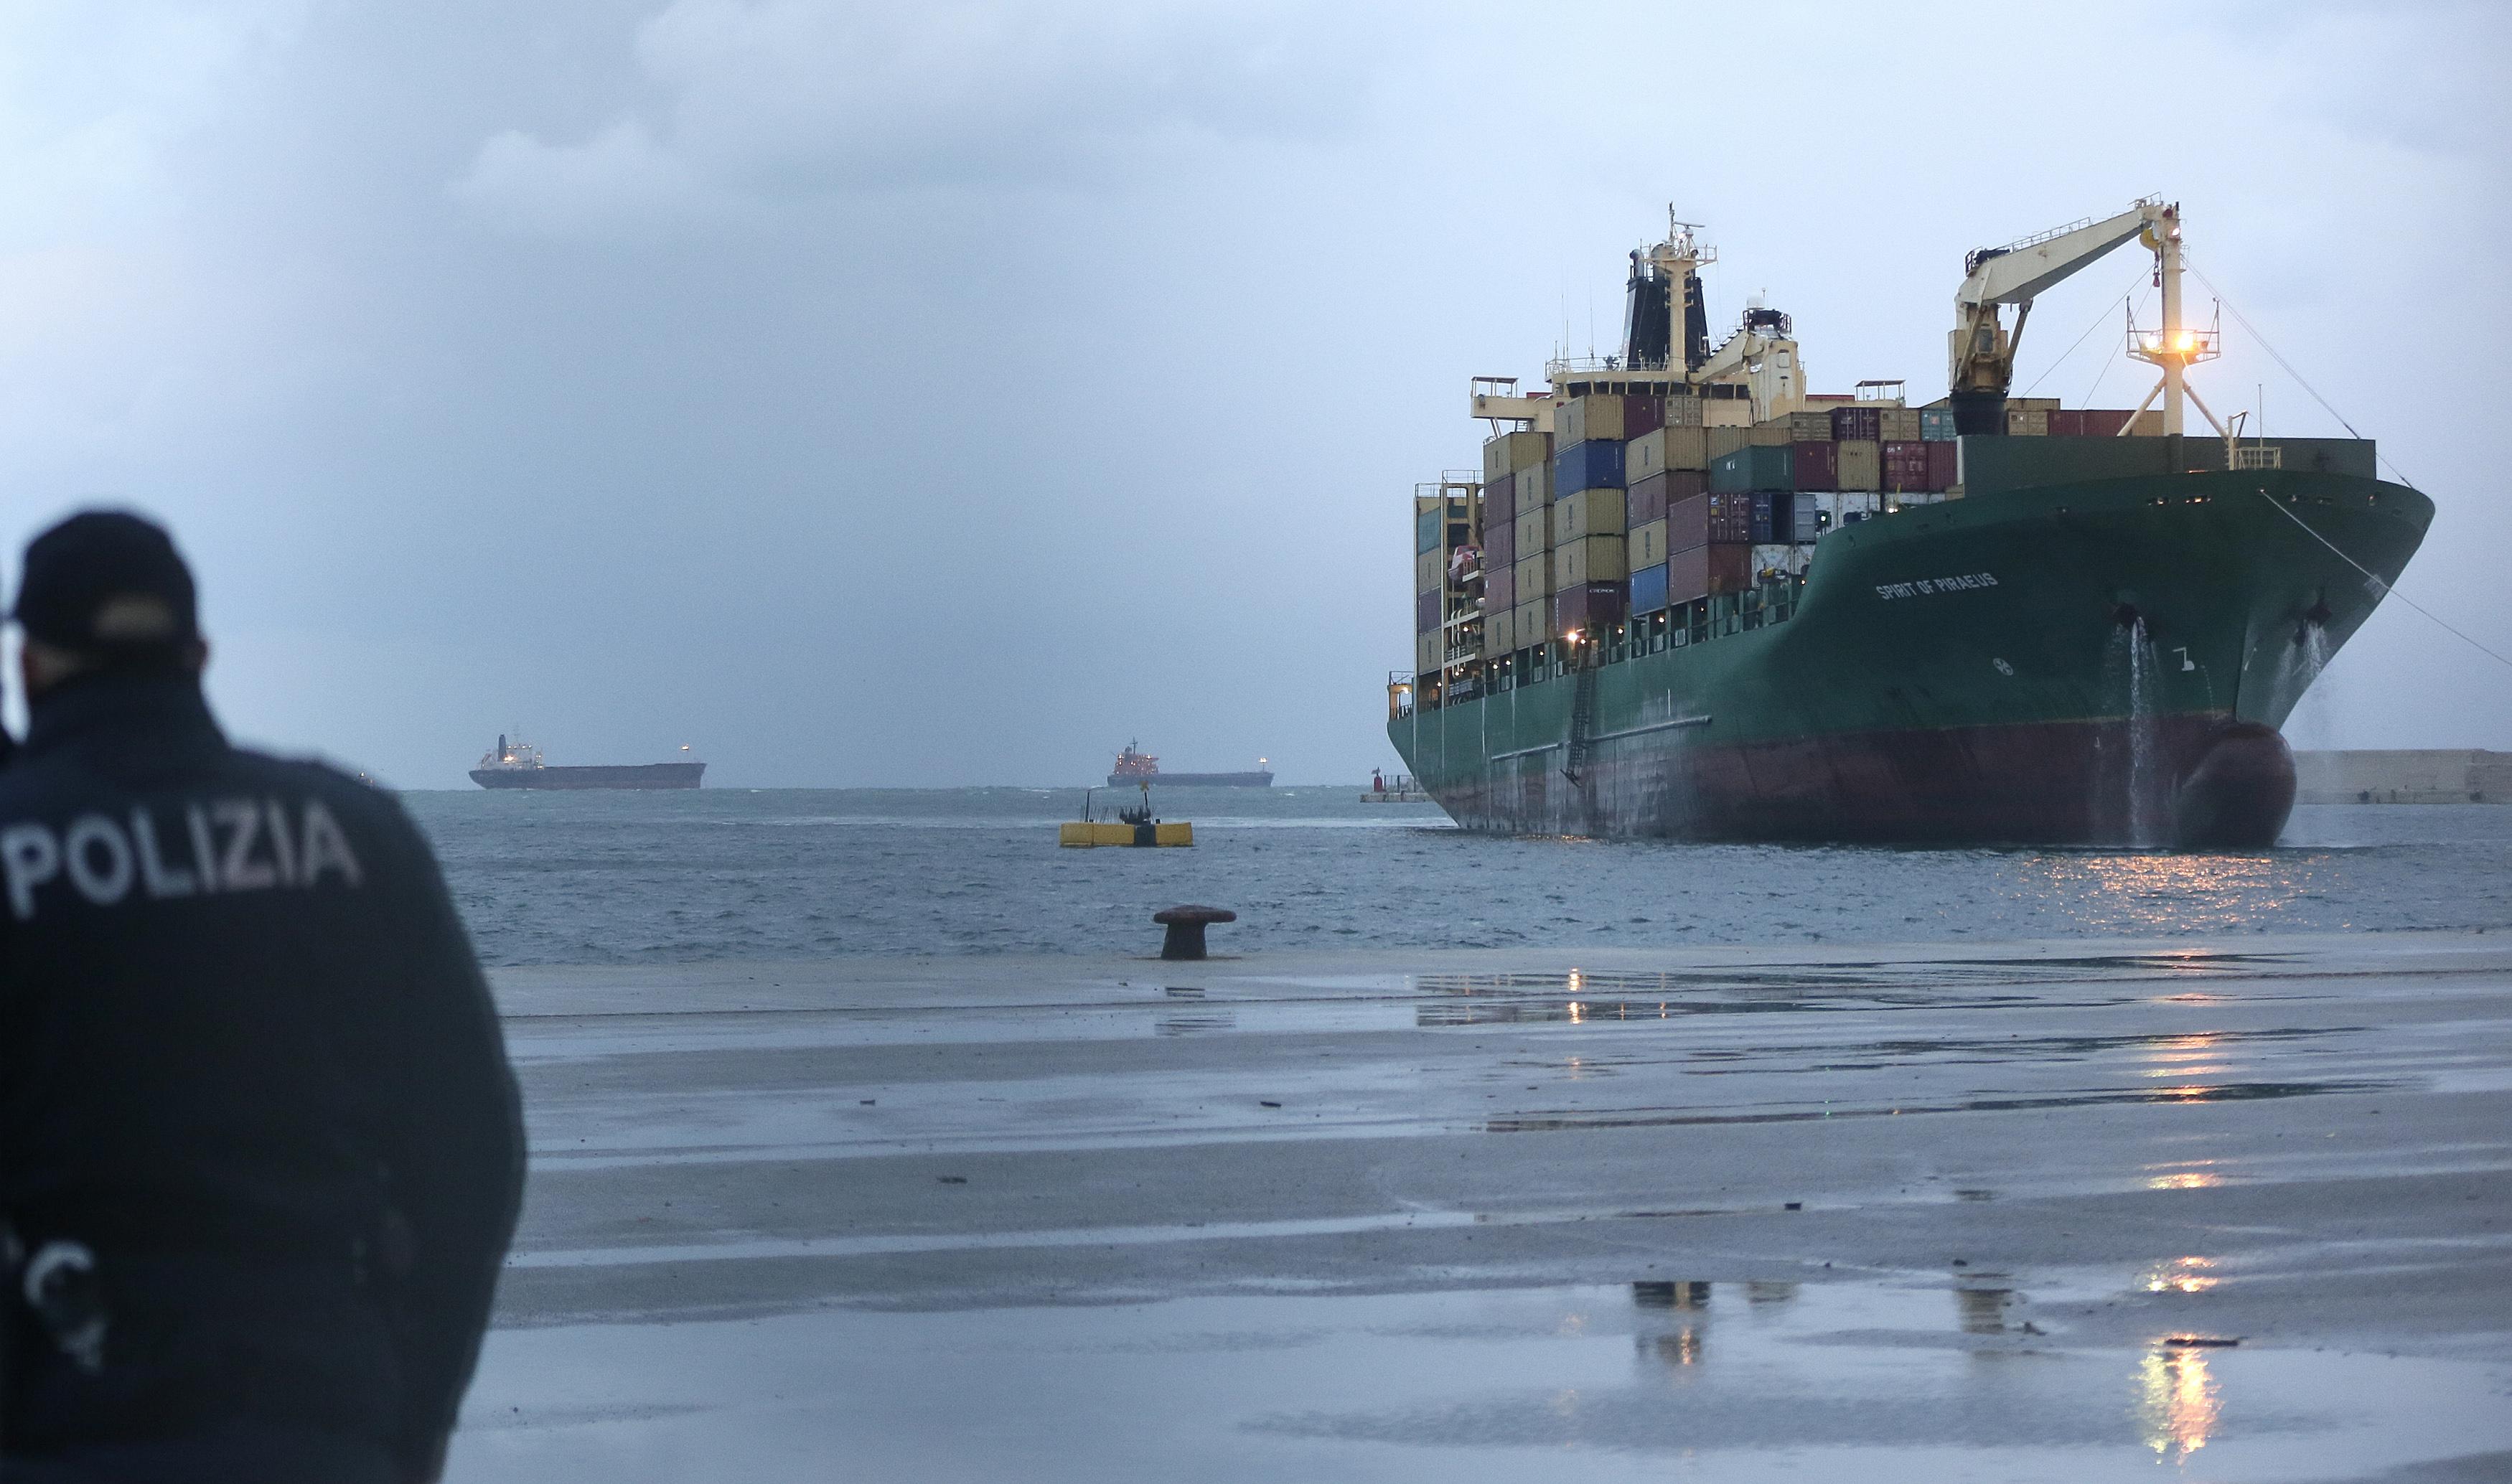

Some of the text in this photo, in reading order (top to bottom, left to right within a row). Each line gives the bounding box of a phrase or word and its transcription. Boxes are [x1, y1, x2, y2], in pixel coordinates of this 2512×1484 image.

[1876, 573, 1999, 600] SPIRIT OF PIRAEUS
[0, 798, 363, 920] POLIZIA
